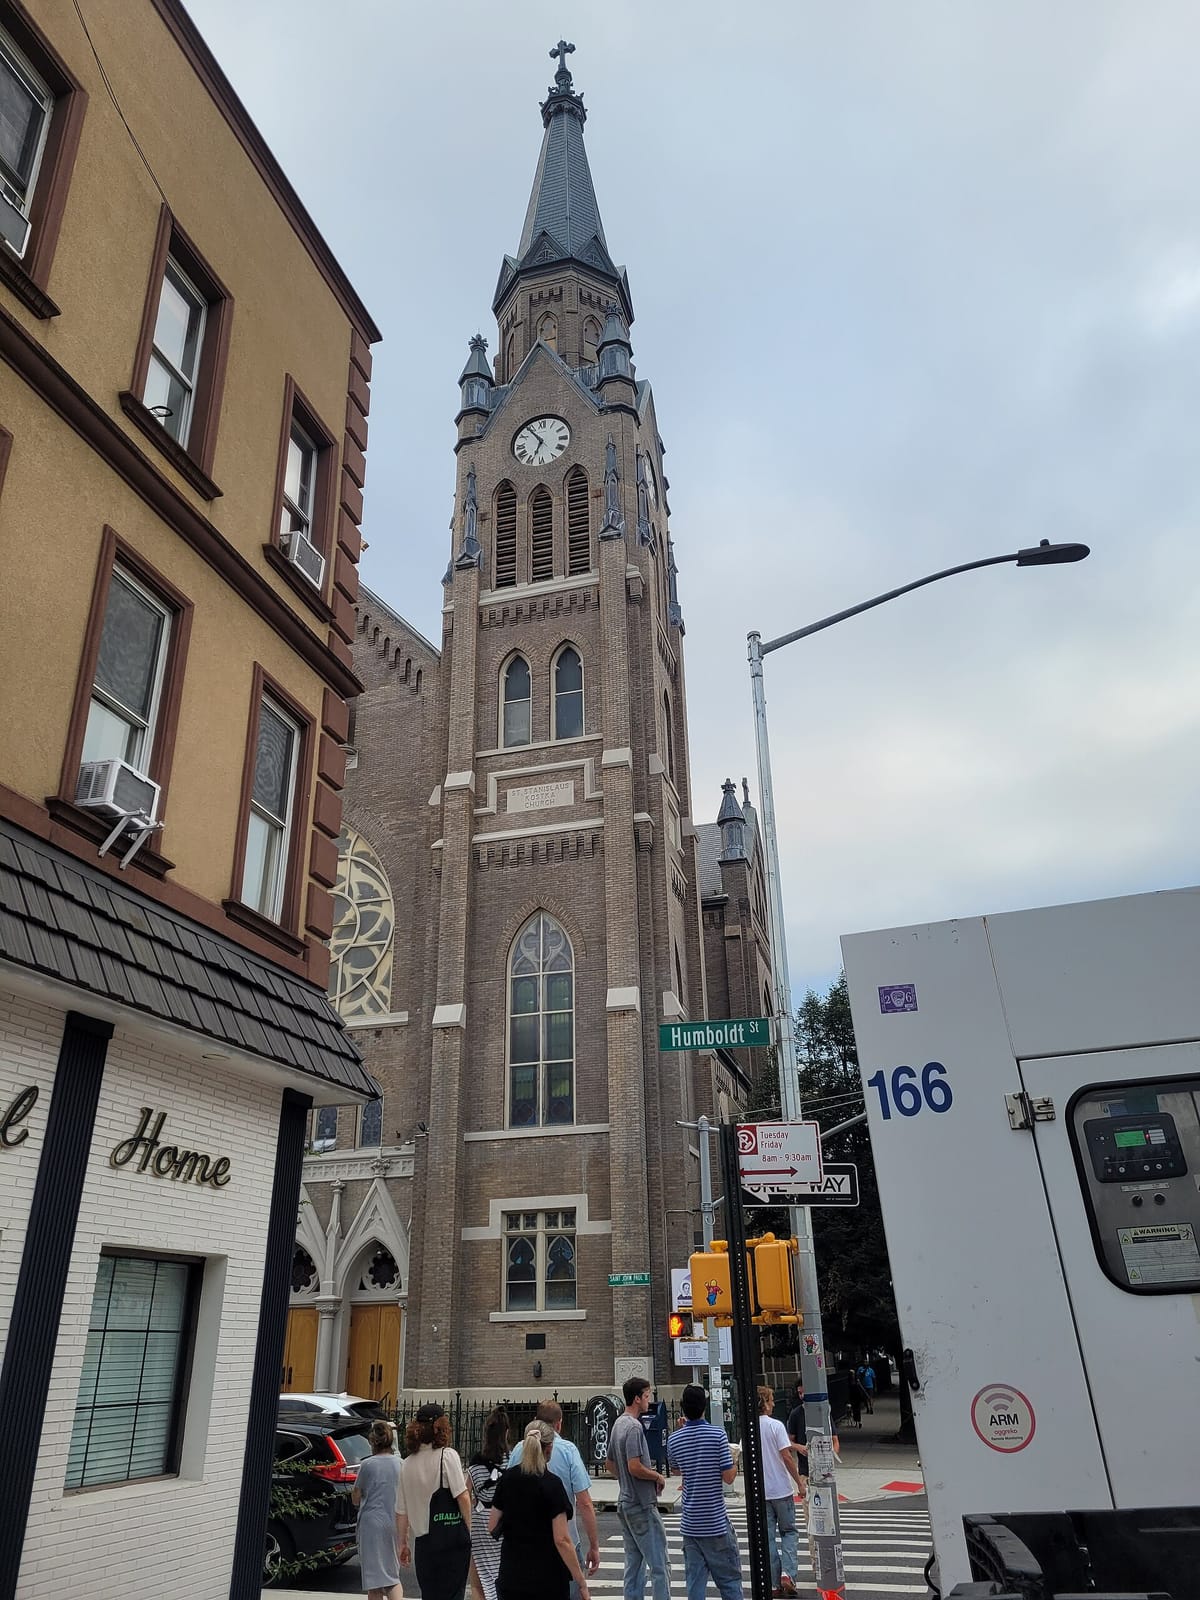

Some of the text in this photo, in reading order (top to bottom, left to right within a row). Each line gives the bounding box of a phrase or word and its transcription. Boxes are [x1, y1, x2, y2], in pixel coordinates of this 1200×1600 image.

[524, 782, 569, 795] STANISLAUS
[525, 791, 555, 801] KOSTKA
[525, 799, 555, 809] CHURCH
[671, 1020, 759, 1047] Humboldt St
[867, 1061, 953, 1121] 166
[760, 1131, 789, 1140] Tuesday
[109, 1106, 232, 1188] Home
[760, 1140, 783, 1149] Friday
[762, 1154, 778, 1162] 8am
[784, 1153, 812, 1162] 9:30am
[1138, 1226, 1176, 1236] WARNING
[990, 1413, 1019, 1426] ARM
